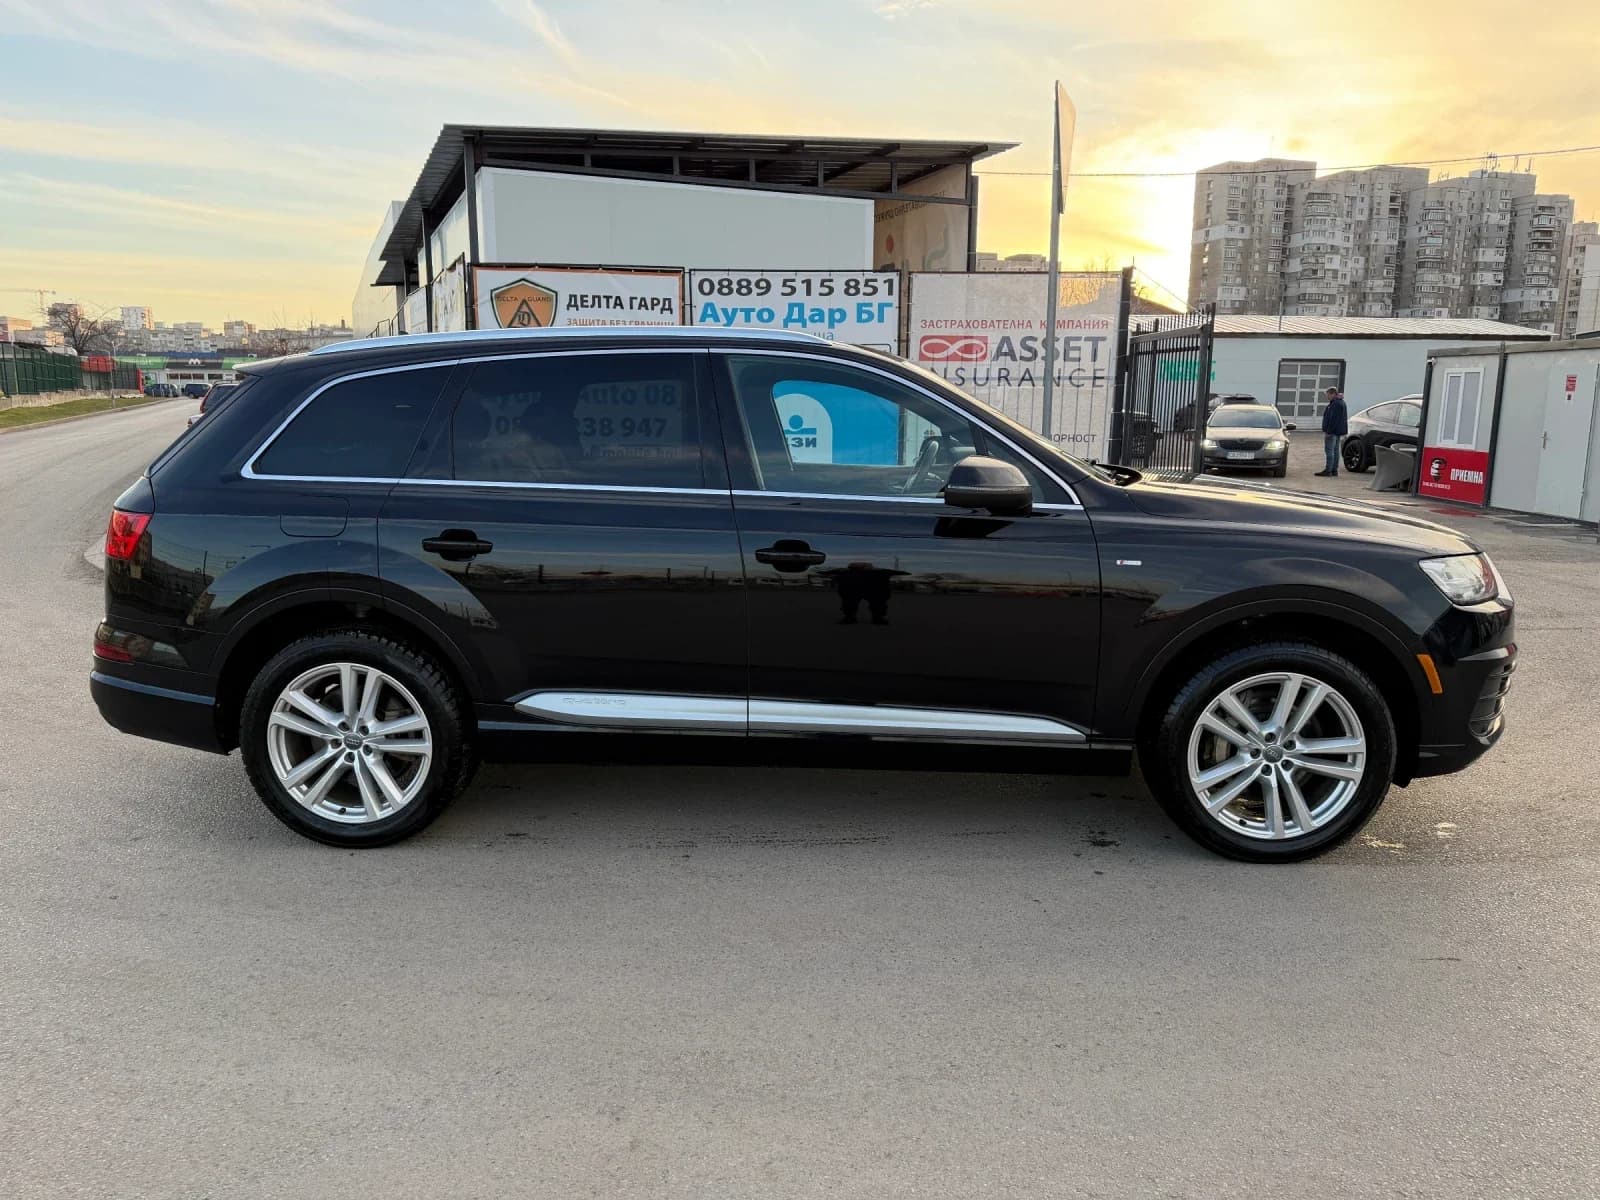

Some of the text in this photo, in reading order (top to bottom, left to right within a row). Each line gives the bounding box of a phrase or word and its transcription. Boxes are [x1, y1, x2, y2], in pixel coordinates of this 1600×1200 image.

[698, 278, 894, 297] 0889 515 851
[566, 294, 674, 314] ДЕЛТА ГАРД
[566, 318, 607, 327] ЗАЩИТА
[698, 302, 894, 329] Ауто Дар БГ
[920, 319, 1109, 330] ЗАСТРАХОВАТЕЛНА КМПАНИЯ
[991, 335, 1108, 363] ASSET
[930, 367, 1106, 388] SURANCE
[620, 415, 667, 438] 947
[787, 437, 817, 448] ЗИ
[1450, 468, 1484, 485] ПРИЕМНА
